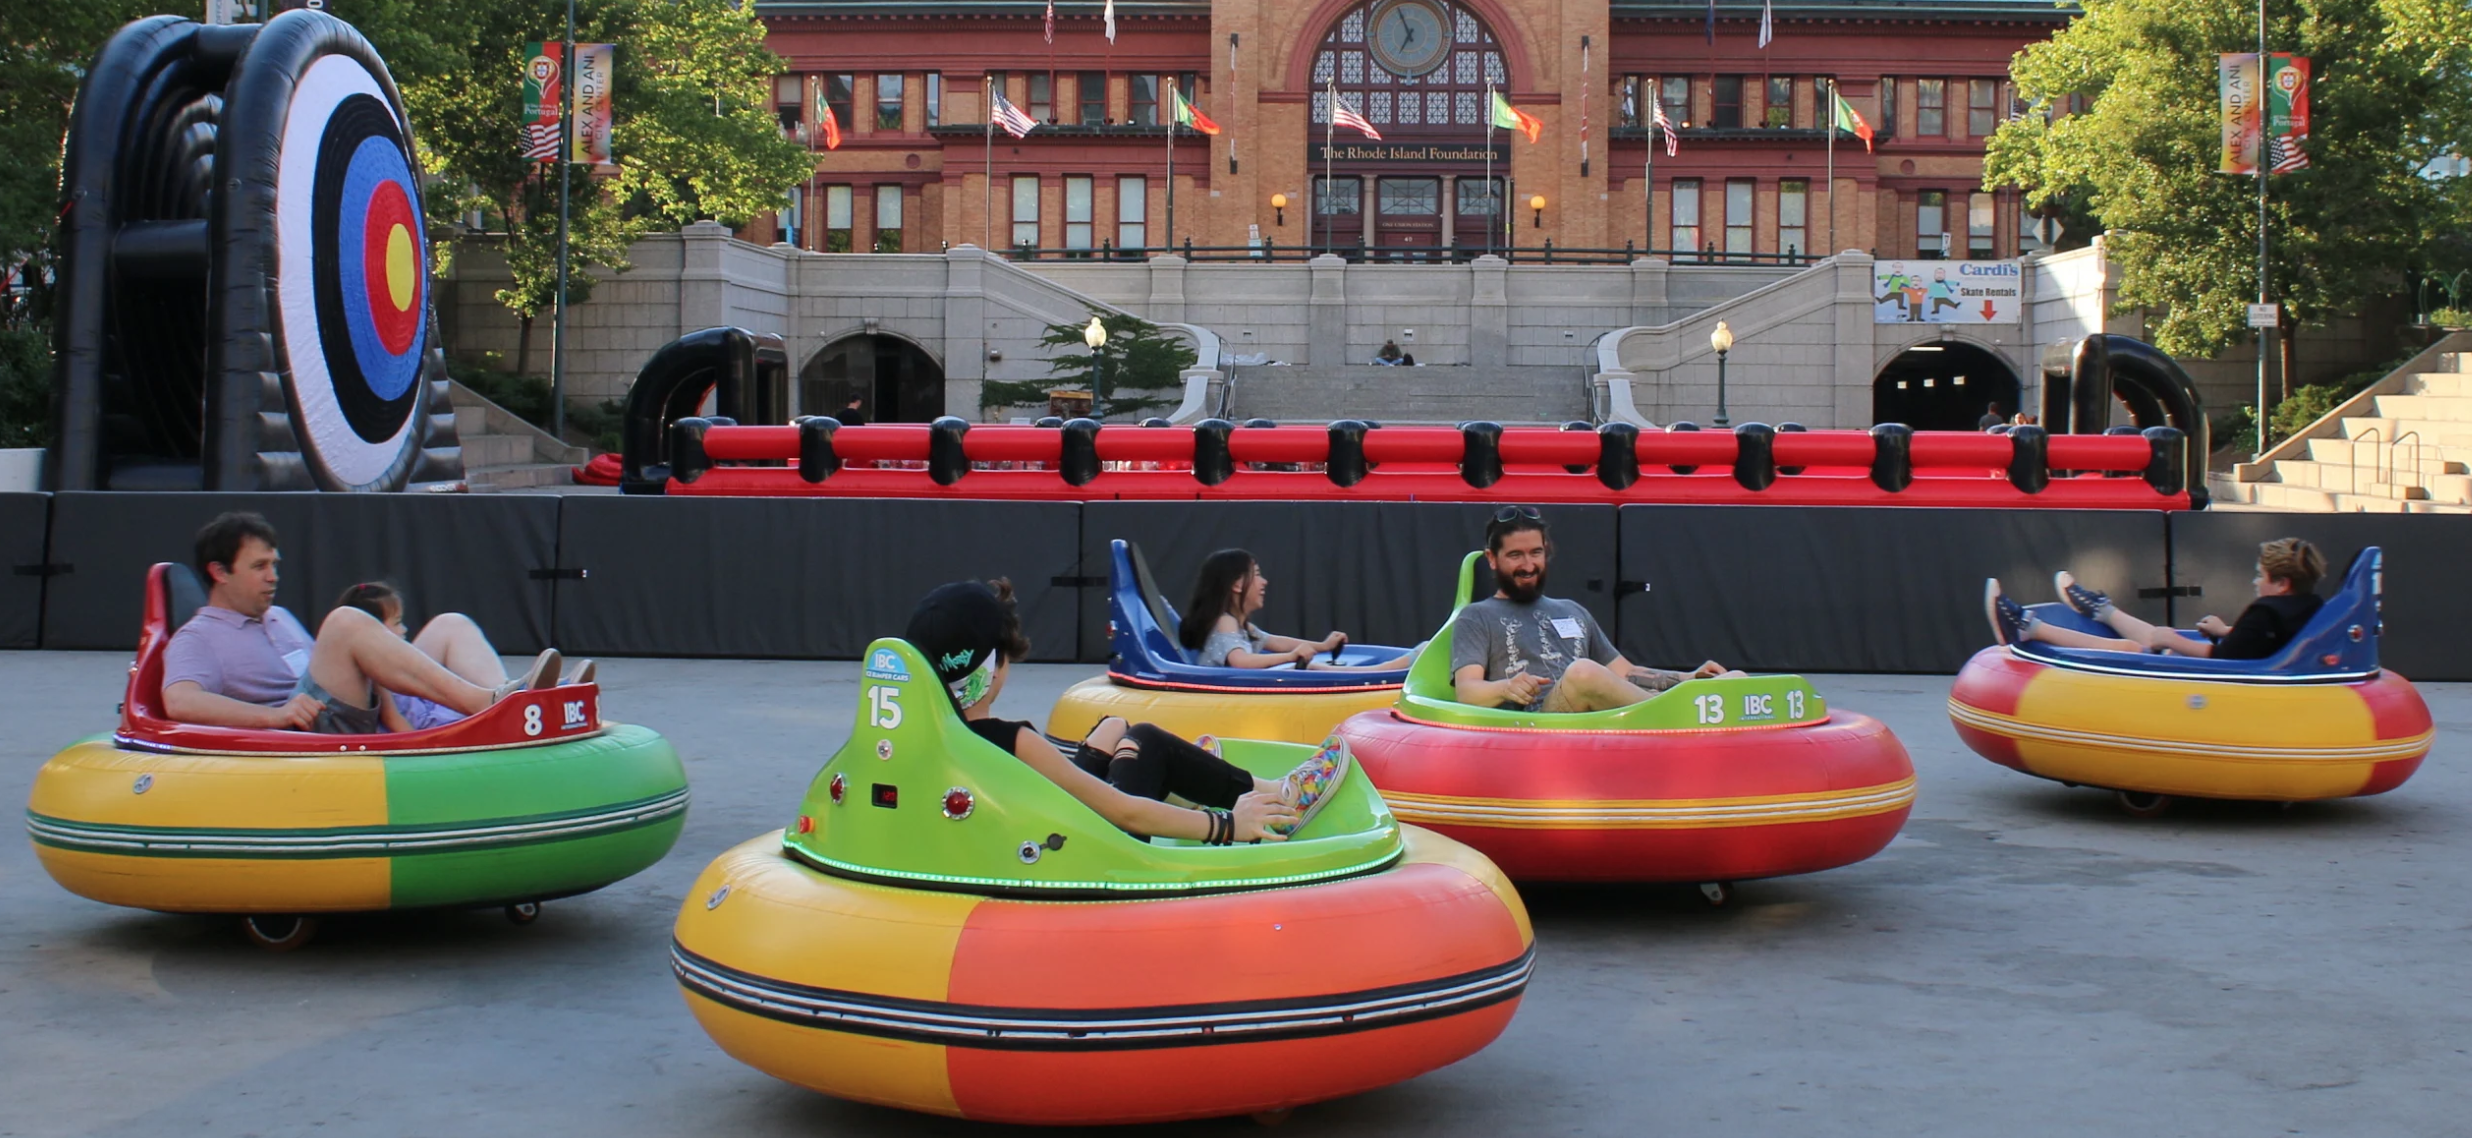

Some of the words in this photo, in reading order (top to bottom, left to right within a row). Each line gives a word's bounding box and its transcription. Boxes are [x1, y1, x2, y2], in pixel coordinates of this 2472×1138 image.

[583, 54, 595, 81] ANI
[2229, 65, 2241, 90] ANI
[582, 84, 594, 116] AND
[596, 72, 604, 111] CENTER
[2242, 81, 2252, 122] CENTER
[523, 106, 558, 117] Portugal
[2230, 94, 2242, 126] AND
[2273, 117, 2305, 127] Portugal
[581, 121, 593, 155] ALEX
[595, 117, 604, 140] CITY
[2242, 126, 2251, 149] CITY
[1319, 147, 1345, 160] The
[1347, 146, 1387, 160] Rhode
[1390, 146, 1426, 160] Island
[1429, 146, 1498, 160] Foundation
[2230, 130, 2241, 165] ALEX
[1959, 263, 2018, 276] Cardi's
[1961, 288, 1983, 297] Skate
[1985, 288, 2016, 297] Rentals
[875, 653, 896, 669] IBC
[563, 700, 586, 724] IBC
[867, 685, 902, 730] 15
[1694, 694, 1725, 724] 13
[1744, 694, 1773, 715] IBC
[1786, 690, 1805, 719] 13
[524, 704, 543, 737] 8
